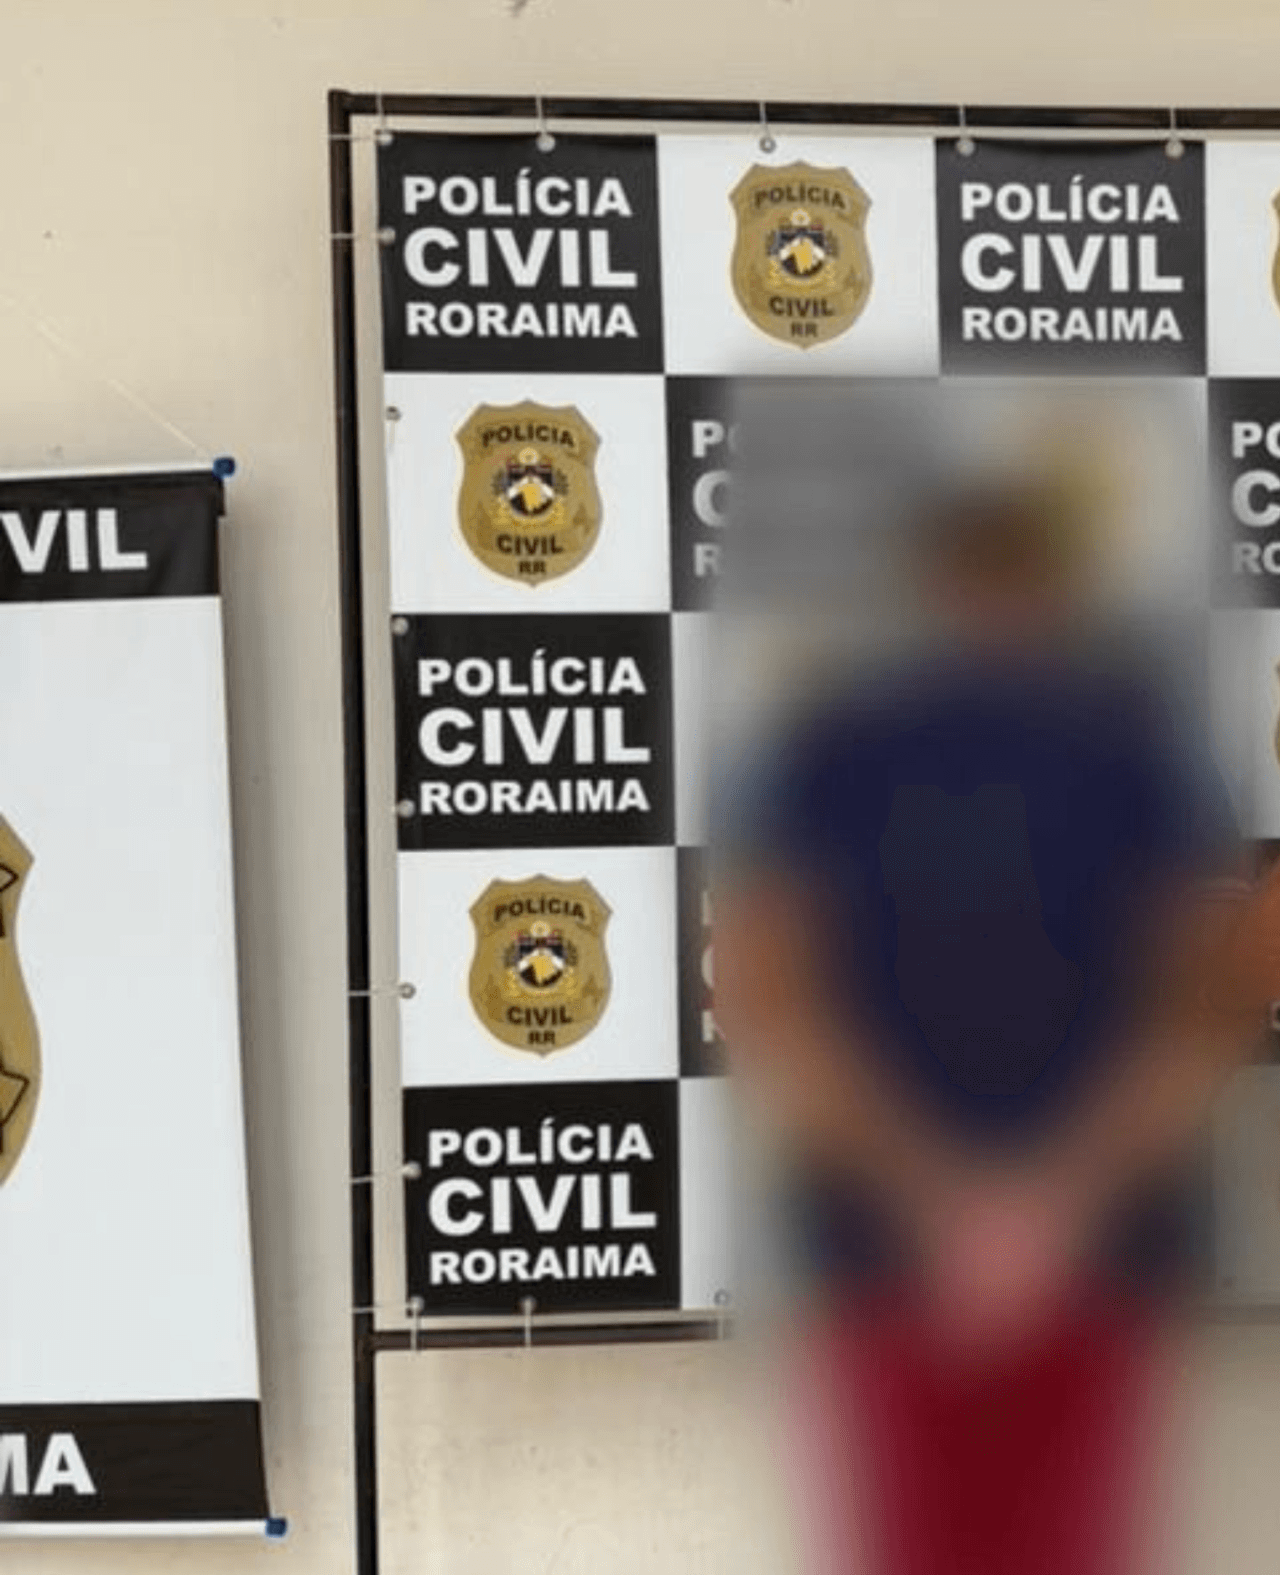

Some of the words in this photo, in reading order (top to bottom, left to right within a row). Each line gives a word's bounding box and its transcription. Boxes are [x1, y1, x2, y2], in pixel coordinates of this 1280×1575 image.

[403, 167, 633, 217] POLÍCIA
[960, 174, 1180, 223] POLÍCIA
[404, 226, 638, 288] CIVIL
[960, 232, 1184, 293] CIVIL
[406, 301, 638, 338] RORAIMA
[769, 296, 834, 317] CIVIL
[962, 306, 1183, 341] RORAIMA
[496, 534, 563, 555] CIVIL
[418, 648, 646, 696] POLÍCIA
[418, 707, 651, 766] CIVIL
[420, 778, 650, 815] RORAIMA
[507, 1006, 572, 1026] CIVIL
[428, 1117, 653, 1168] POLÍCIA
[428, 1173, 657, 1236] CIVIL
[430, 1243, 656, 1285] RORAIMA
